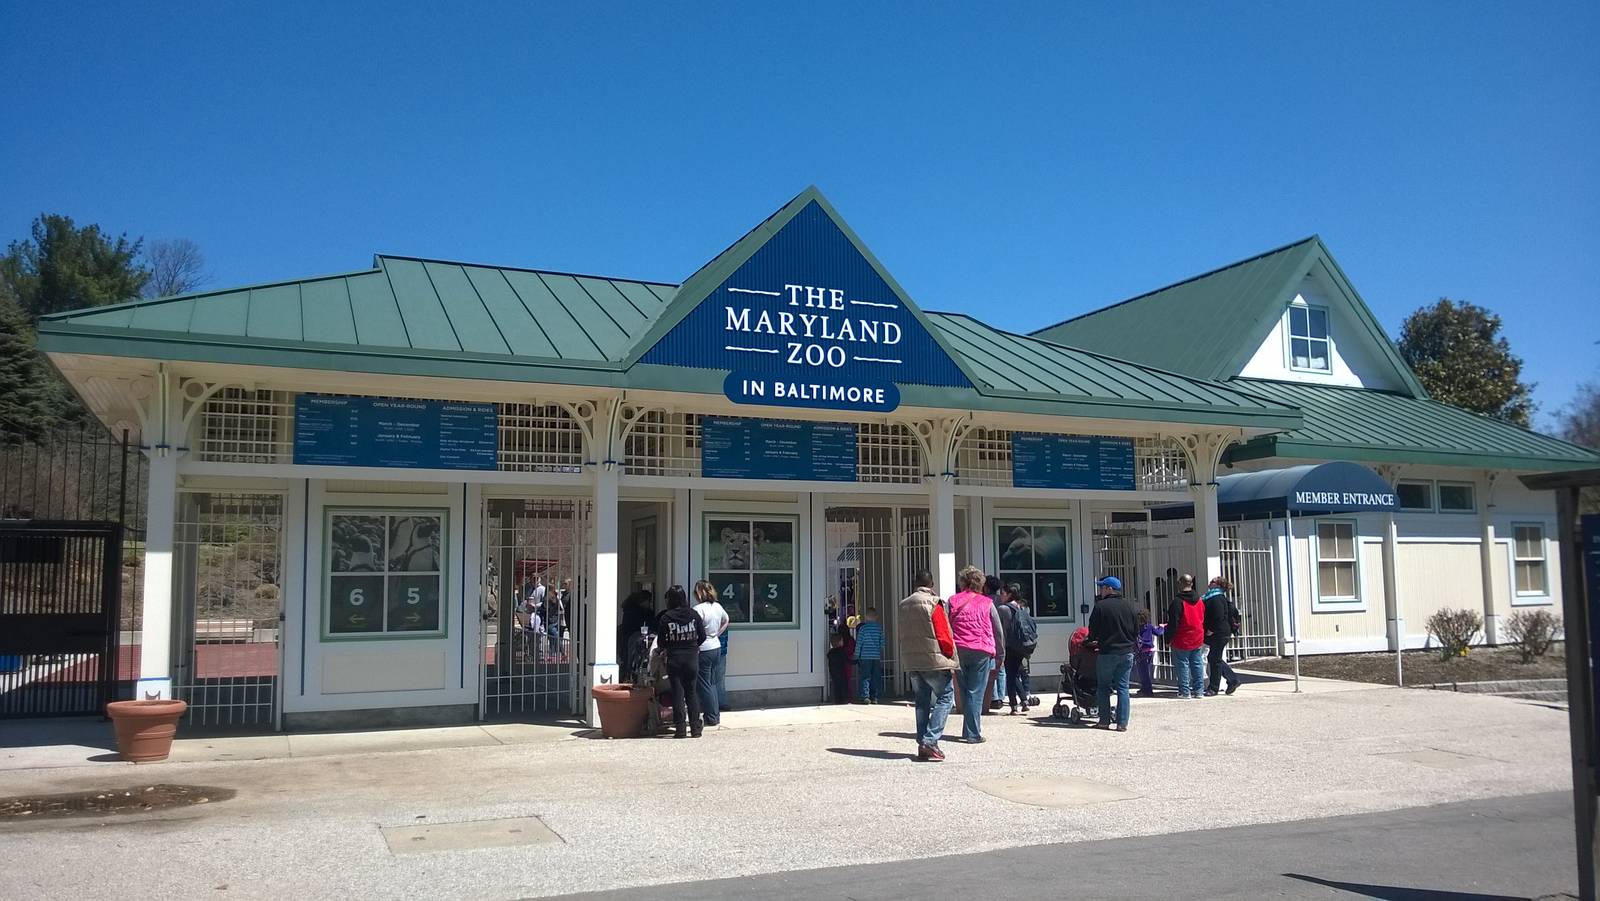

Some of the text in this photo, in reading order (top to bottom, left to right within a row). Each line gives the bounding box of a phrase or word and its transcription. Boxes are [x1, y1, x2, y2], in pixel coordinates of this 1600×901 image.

[785, 284, 844, 310] THE
[725, 306, 901, 344] MARYLAND
[787, 343, 846, 367] ZOO
[743, 380, 885, 403] IN BALTIMORE
[1296, 492, 1394, 506] MEMBER ENTRANCE
[350, 588, 364, 606] 6
[407, 587, 420, 605] 5
[722, 583, 735, 599] 4
[767, 583, 778, 599] 3
[1048, 582, 1054, 597] 1
[667, 619, 696, 635] PINK
